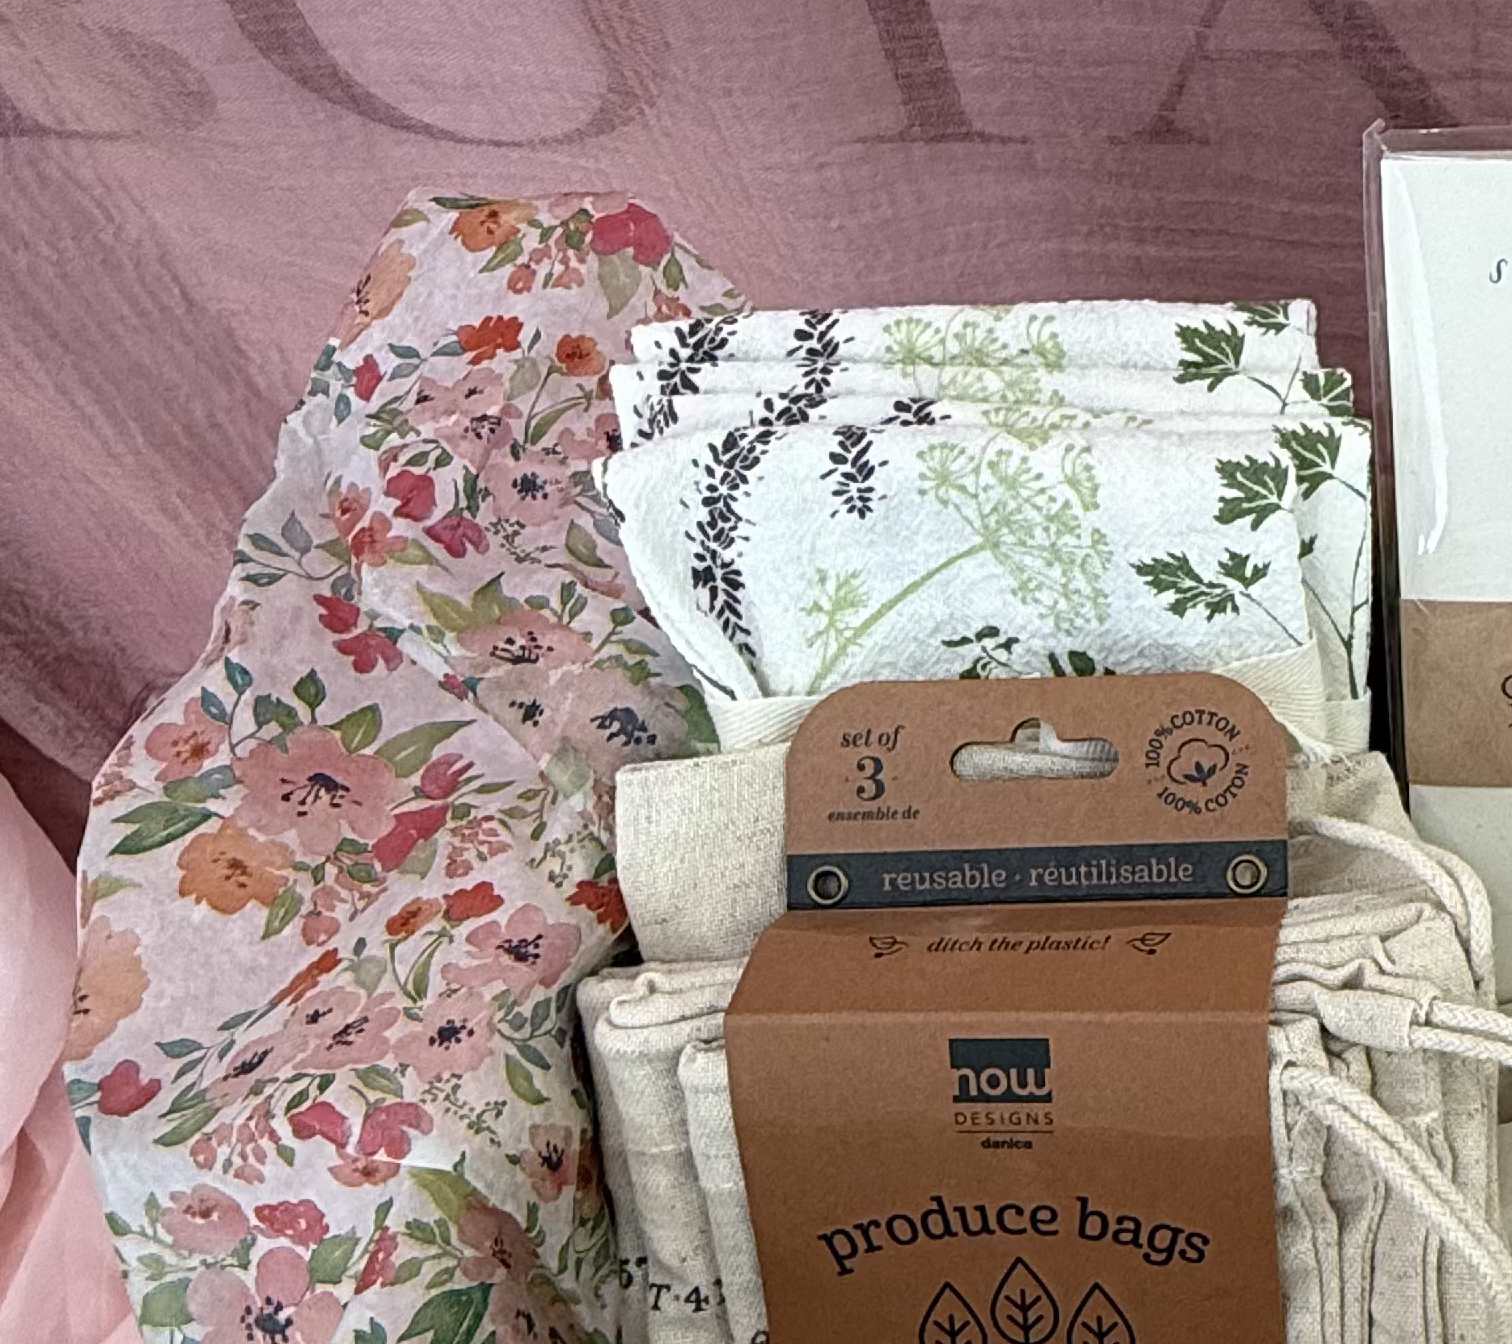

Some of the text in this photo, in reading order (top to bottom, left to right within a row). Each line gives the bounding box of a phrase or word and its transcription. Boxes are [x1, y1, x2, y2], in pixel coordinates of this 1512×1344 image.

[1488, 257, 1508, 284] s
[841, 724, 906, 752] set of
[1144, 709, 1241, 768] 100% COTTON
[856, 755, 886, 802] 3
[1156, 762, 1250, 815] 100% COTON
[827, 805, 921, 822] ensemble de
[882, 856, 1195, 893] reusable réutilisable
[926, 933, 1111, 955] ditch the plastic!
[951, 1067, 1055, 1096] now
[953, 1111, 1055, 1126] DESIGNS
[980, 1137, 1034, 1150] danica
[817, 1196, 1211, 1275] produce bags
